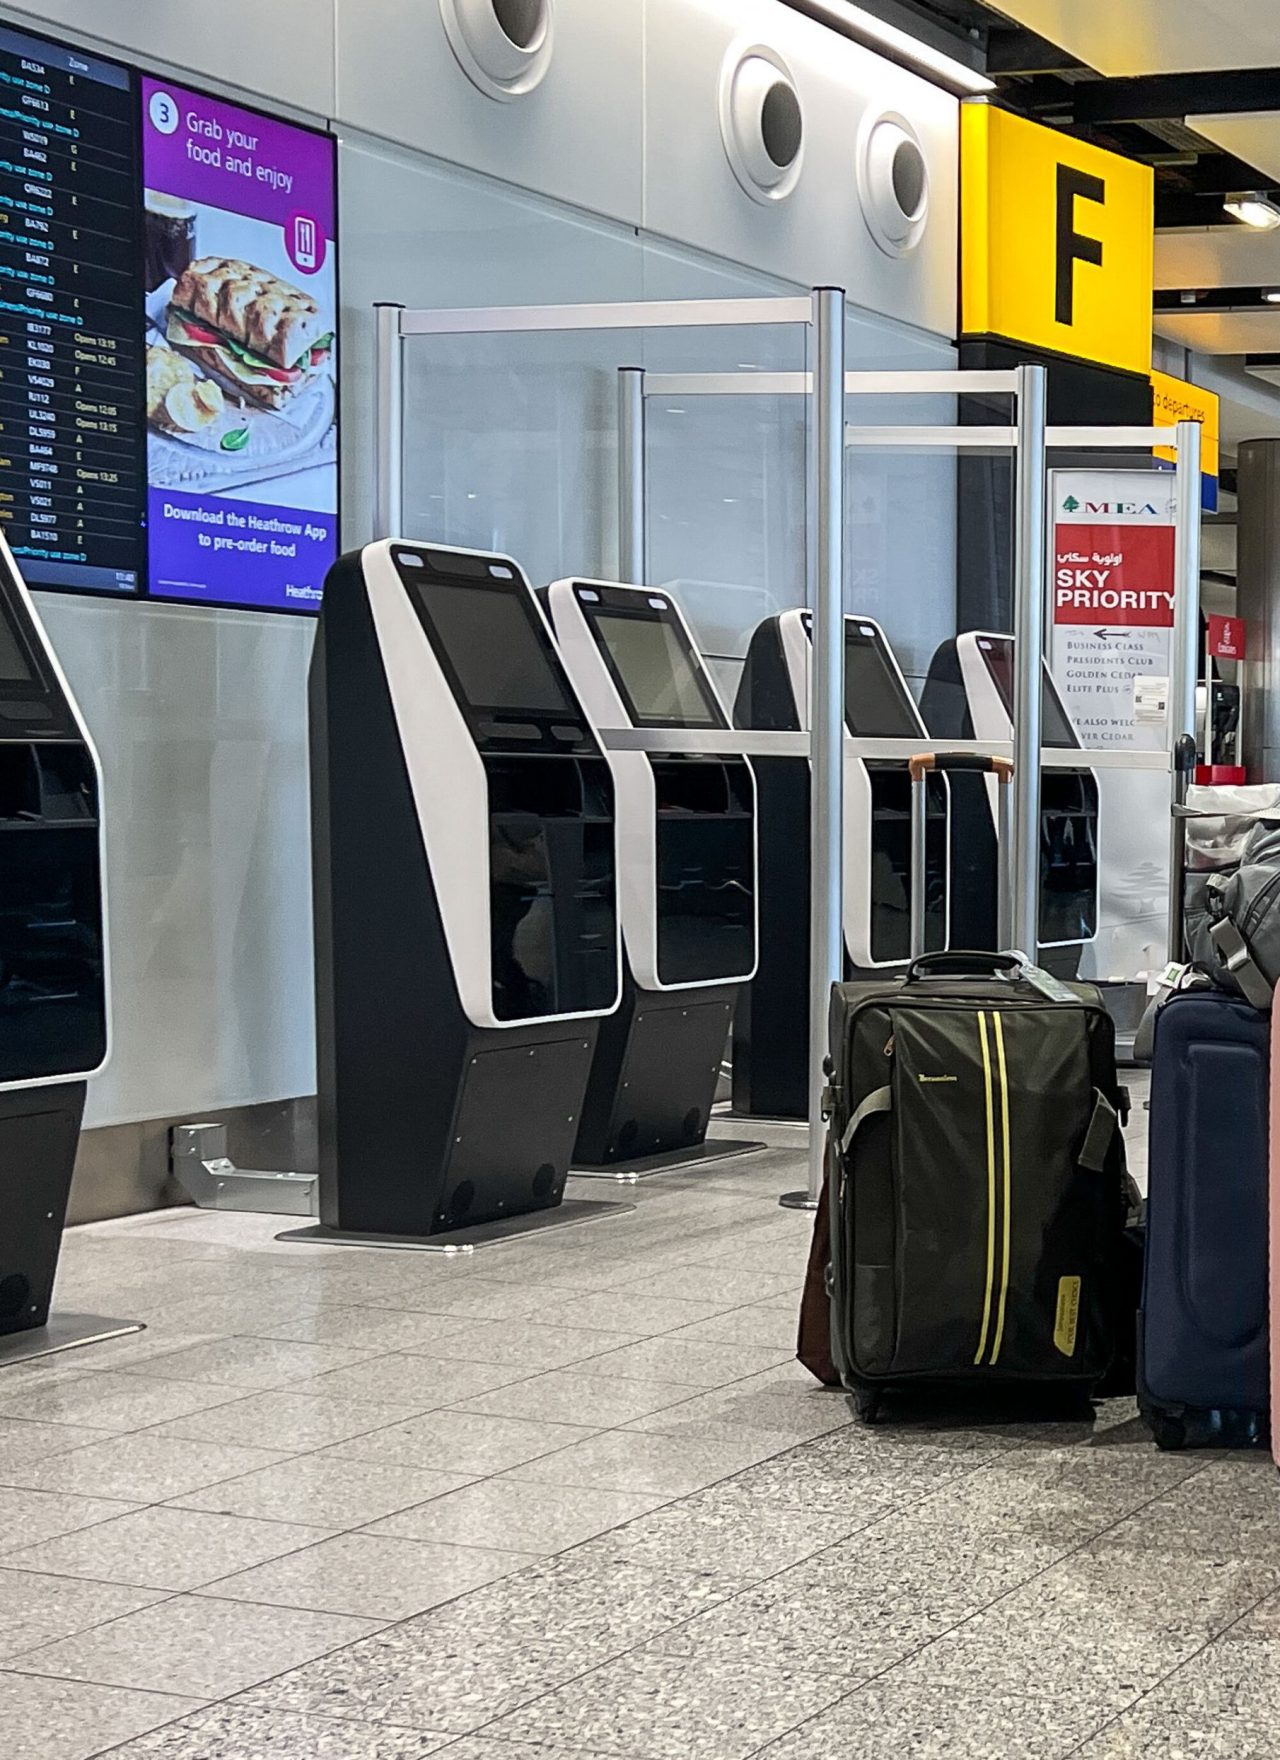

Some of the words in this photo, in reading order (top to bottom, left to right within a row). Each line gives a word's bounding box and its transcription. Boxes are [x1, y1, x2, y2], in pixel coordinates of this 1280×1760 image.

[69, 56, 88, 71] Zone
[158, 103, 170, 123] 3
[186, 111, 223, 141] Grab
[226, 130, 258, 151] your
[186, 140, 221, 168] food
[225, 153, 251, 177] and
[255, 165, 293, 194] enjoy
[1055, 162, 1105, 327] F
[74, 333, 97, 345] Opens
[75, 350, 97, 363] Opens
[75, 384, 82, 393] A
[75, 401, 98, 413] Opens
[1163, 394, 1206, 421] departures
[76, 417, 98, 430] Opens
[76, 434, 83, 444] A
[76, 451, 82, 461] E
[76, 468, 98, 480] Opens
[76, 485, 84, 494] A
[77, 502, 84, 511] A
[1085, 502, 1160, 515] MEA
[77, 519, 84, 528] A
[163, 503, 224, 525] Download
[227, 512, 246, 528] the
[248, 515, 303, 535] Heathrow
[304, 524, 328, 542] App
[77, 535, 83, 545] E
[198, 533, 211, 547] to
[213, 537, 268, 553] pre-order
[270, 541, 296, 557] food
[1057, 568, 1110, 588] SKY
[285, 584, 324, 600] Heathro
[1057, 589, 1176, 609] PRIORITY
[1067, 641, 1112, 650] BUSINESS
[1115, 642, 1144, 651] CLASS
[1067, 655, 1125, 665] PRESIDENTS
[1128, 657, 1153, 665] CLUB
[1066, 670, 1108, 679] GOLDEN
[1111, 671, 1143, 680] CEDA
[1066, 684, 1092, 693] ELITE
[1096, 685, 1119, 693] PLUS
[1083, 718, 1108, 726] ALSO
[1111, 719, 1136, 727] WELC
